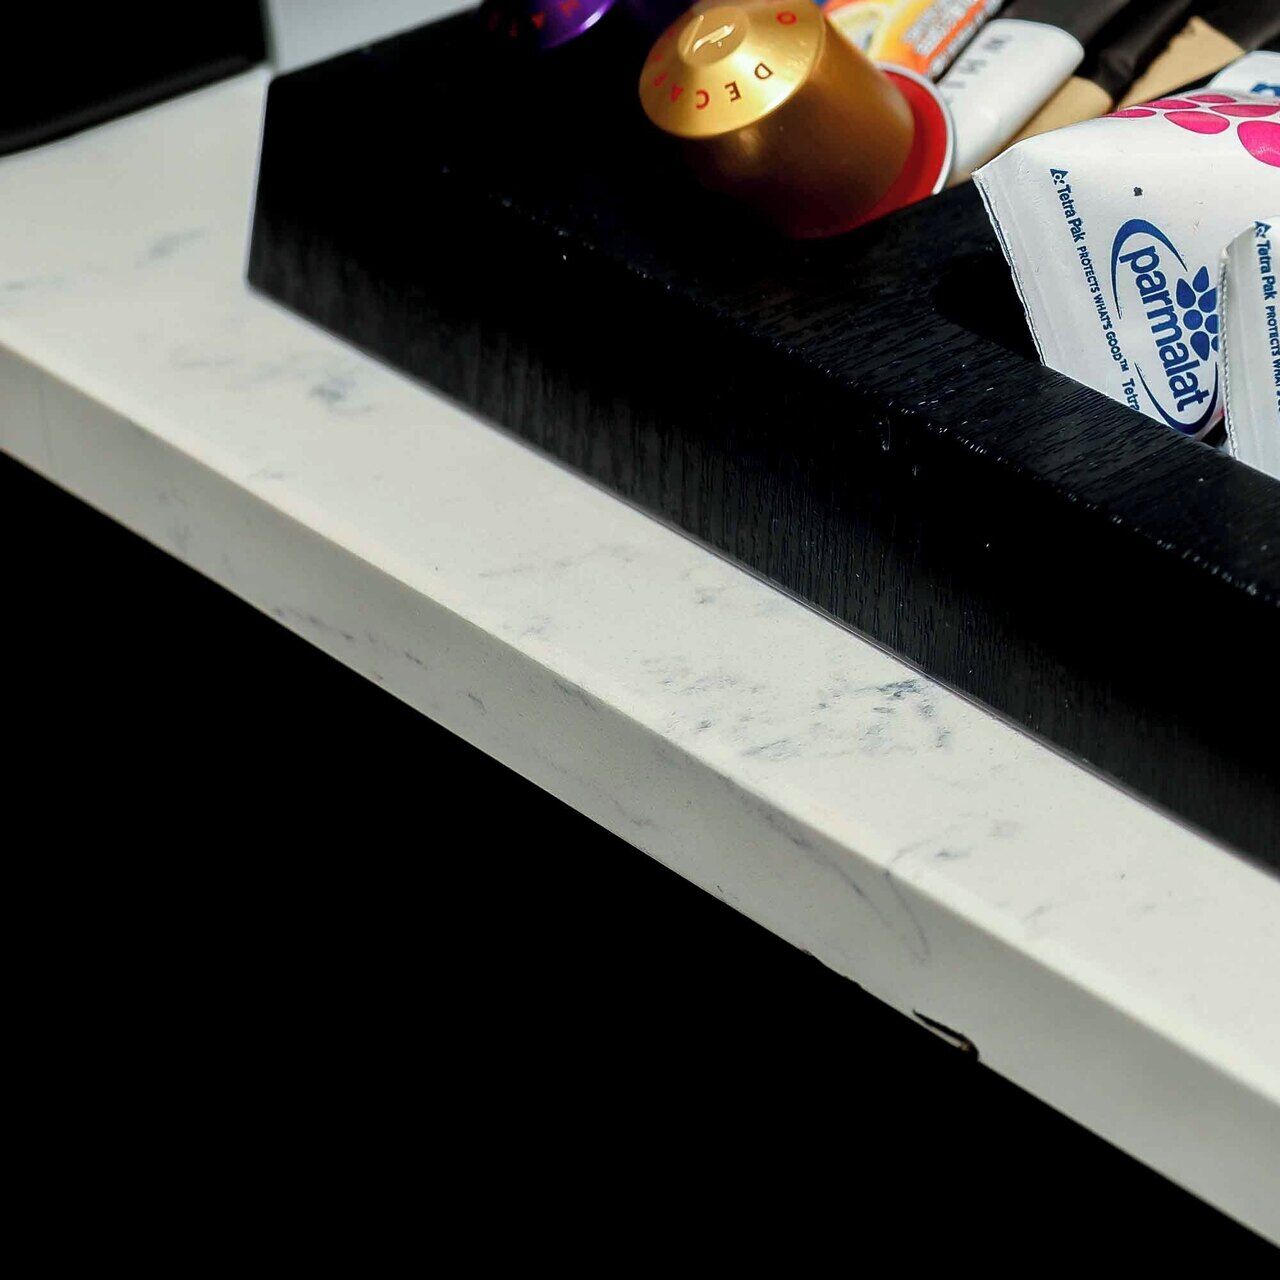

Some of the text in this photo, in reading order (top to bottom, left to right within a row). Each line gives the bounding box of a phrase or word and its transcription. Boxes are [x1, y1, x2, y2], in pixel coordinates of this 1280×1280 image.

[1057, 184, 1075, 219] Tetra
[1067, 218, 1087, 243] Pak
[1077, 245, 1100, 294] PROTECTS
[1093, 293, 1113, 331] WHAT'S
[1257, 240, 1271, 274] Tetra
[1262, 274, 1278, 300] Pak
[1119, 245, 1210, 412] parmalat
